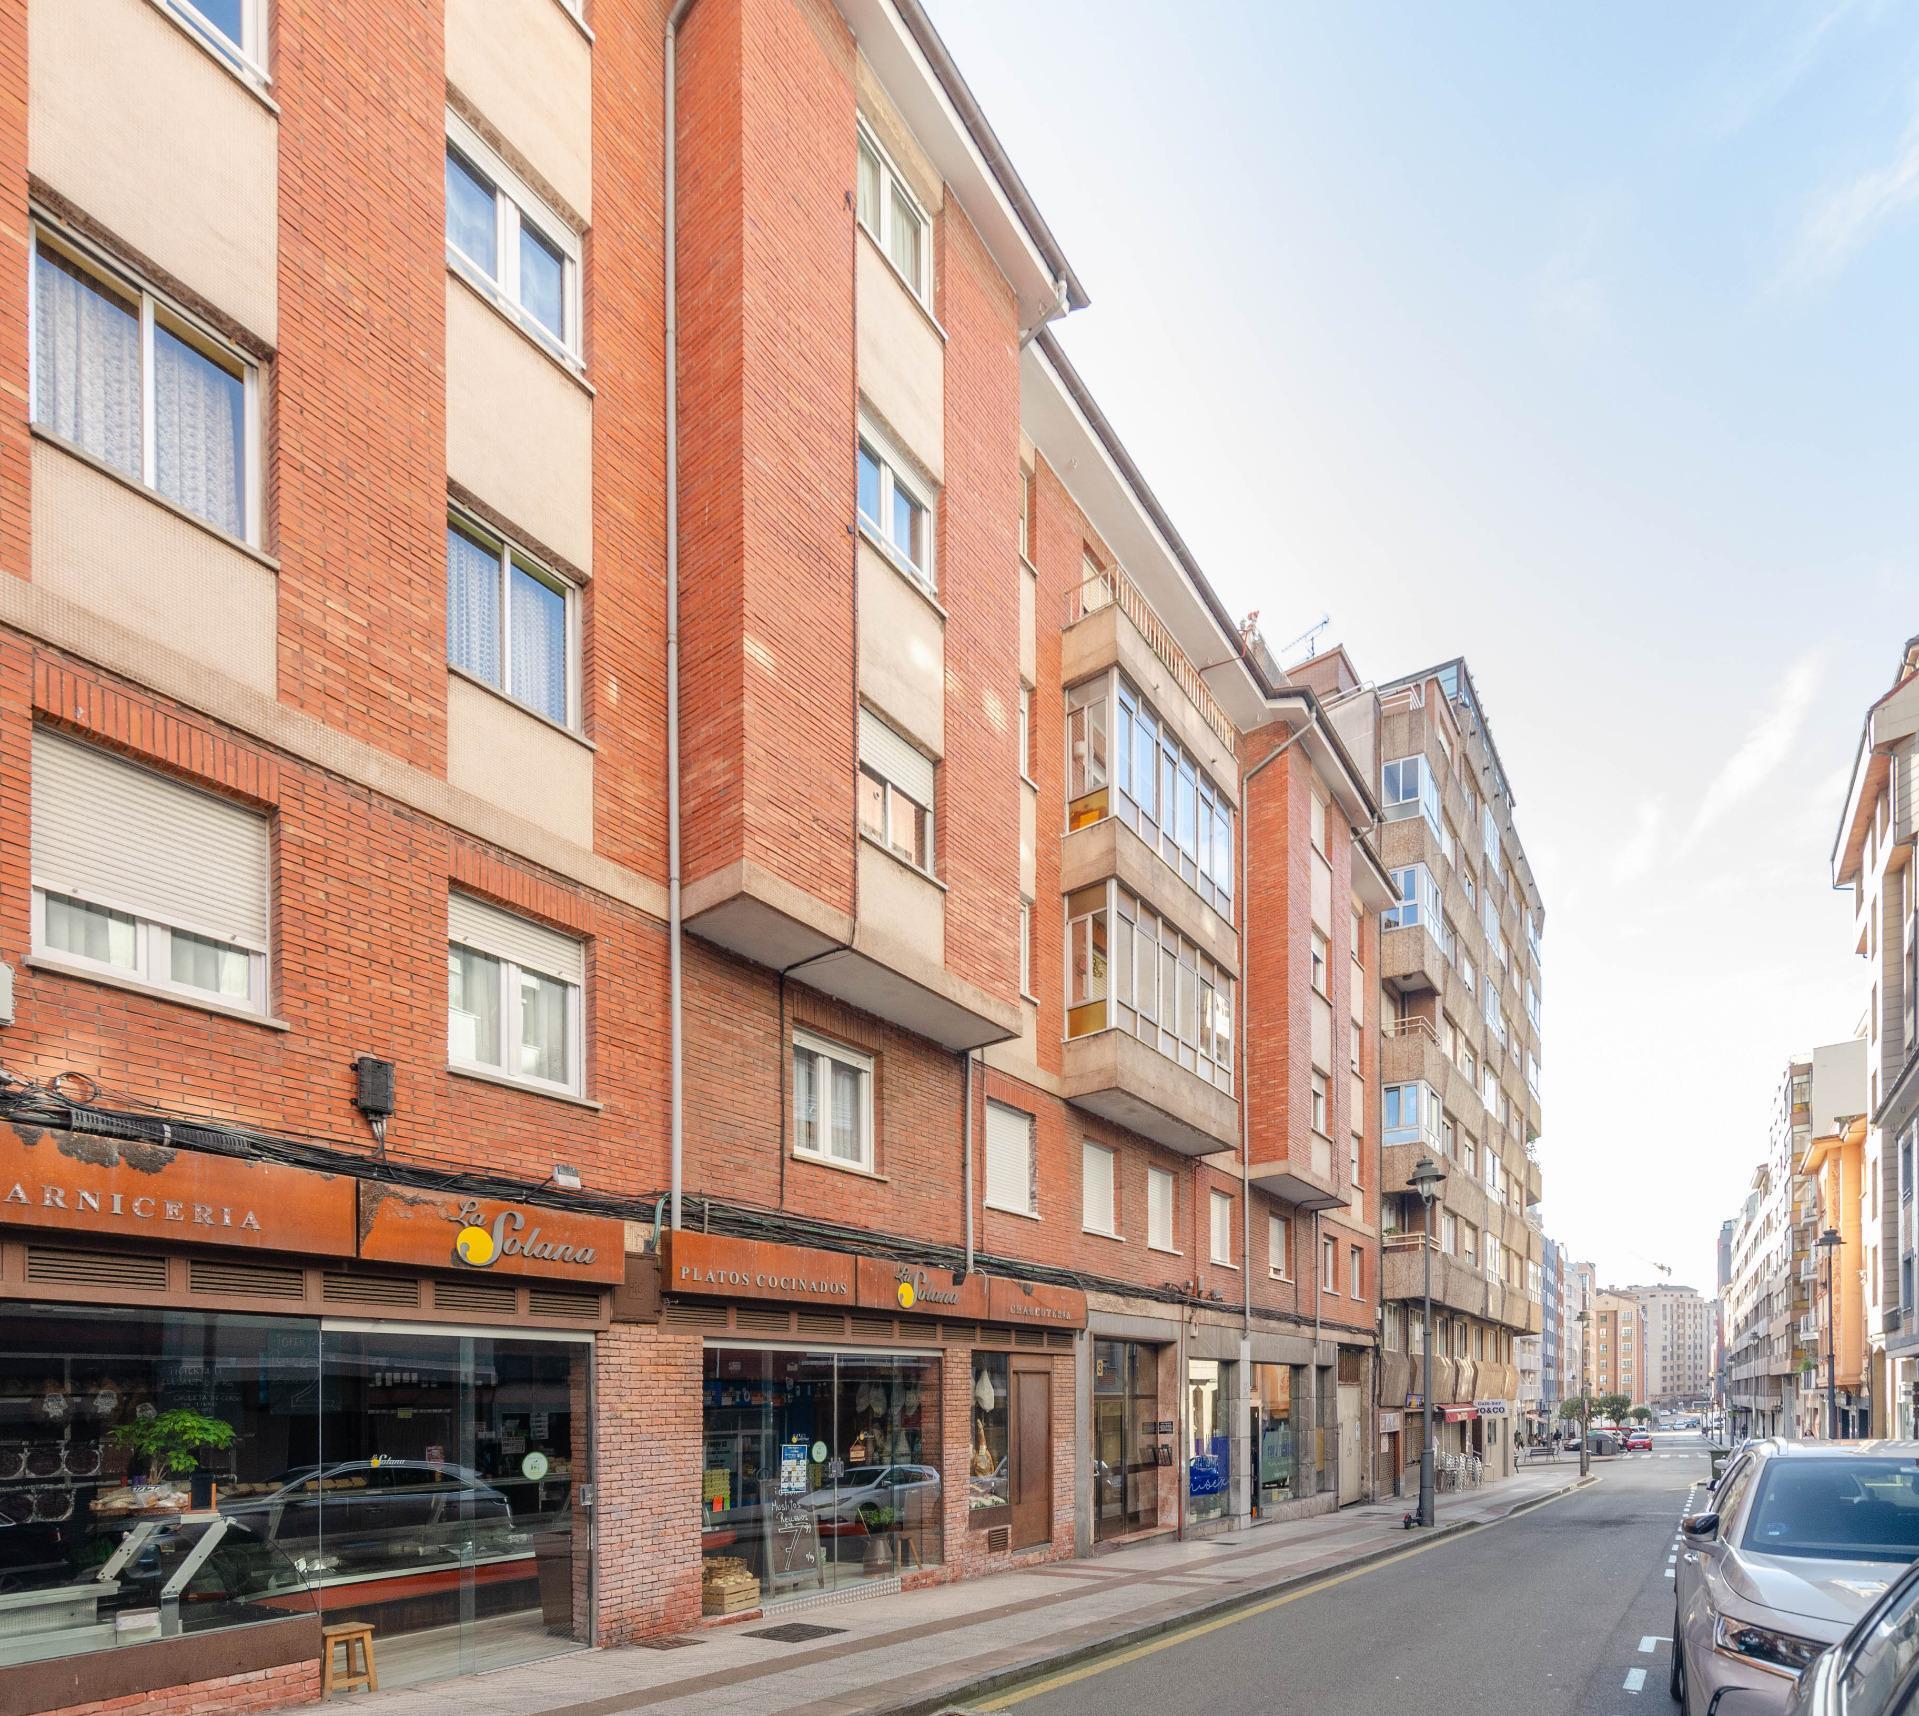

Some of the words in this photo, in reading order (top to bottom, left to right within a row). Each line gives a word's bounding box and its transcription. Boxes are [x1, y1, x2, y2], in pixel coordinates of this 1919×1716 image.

[5, 1182, 262, 1232] ARNICERIA
[449, 1200, 487, 1227] La
[456, 1210, 597, 1267] Solana
[680, 1265, 749, 1286] PLATOS
[756, 1274, 848, 1295] COCINADOS
[897, 1271, 959, 1309] Solana
[1097, 1362, 1103, 1374] 3
[1478, 1406, 1506, 1414] O&CO
